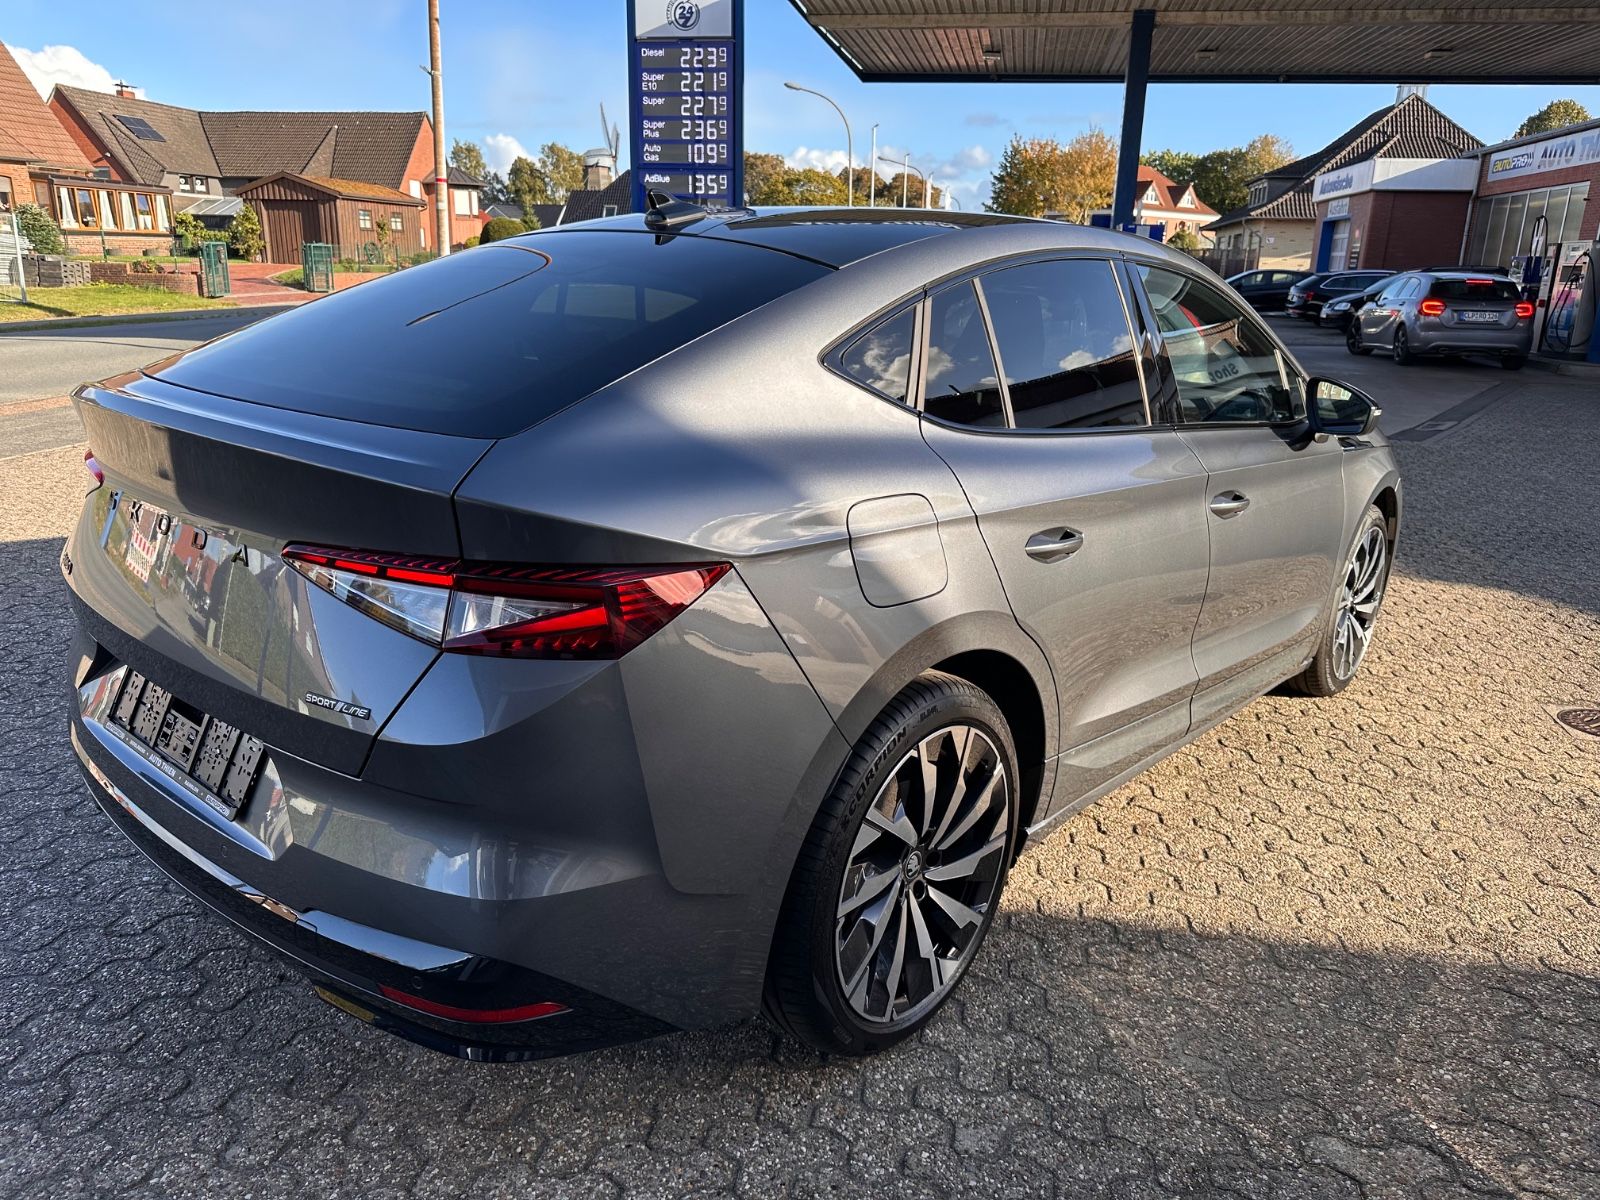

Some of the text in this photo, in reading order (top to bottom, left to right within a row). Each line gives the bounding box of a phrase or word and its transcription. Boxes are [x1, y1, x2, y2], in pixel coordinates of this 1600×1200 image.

[641, 48, 665, 57] Diesel
[642, 72, 664, 83] Super
[642, 82, 657, 91] E10
[642, 97, 665, 107] Super
[643, 120, 665, 130] Super
[643, 130, 660, 138] Plus
[643, 144, 662, 153] Auto
[643, 153, 660, 162] Gas
[1538, 139, 1576, 169] AUTO
[644, 174, 671, 184] AdBlue
[306, 693, 368, 717] SPORT LINE
[149, 754, 177, 777] AUTO THIEN
